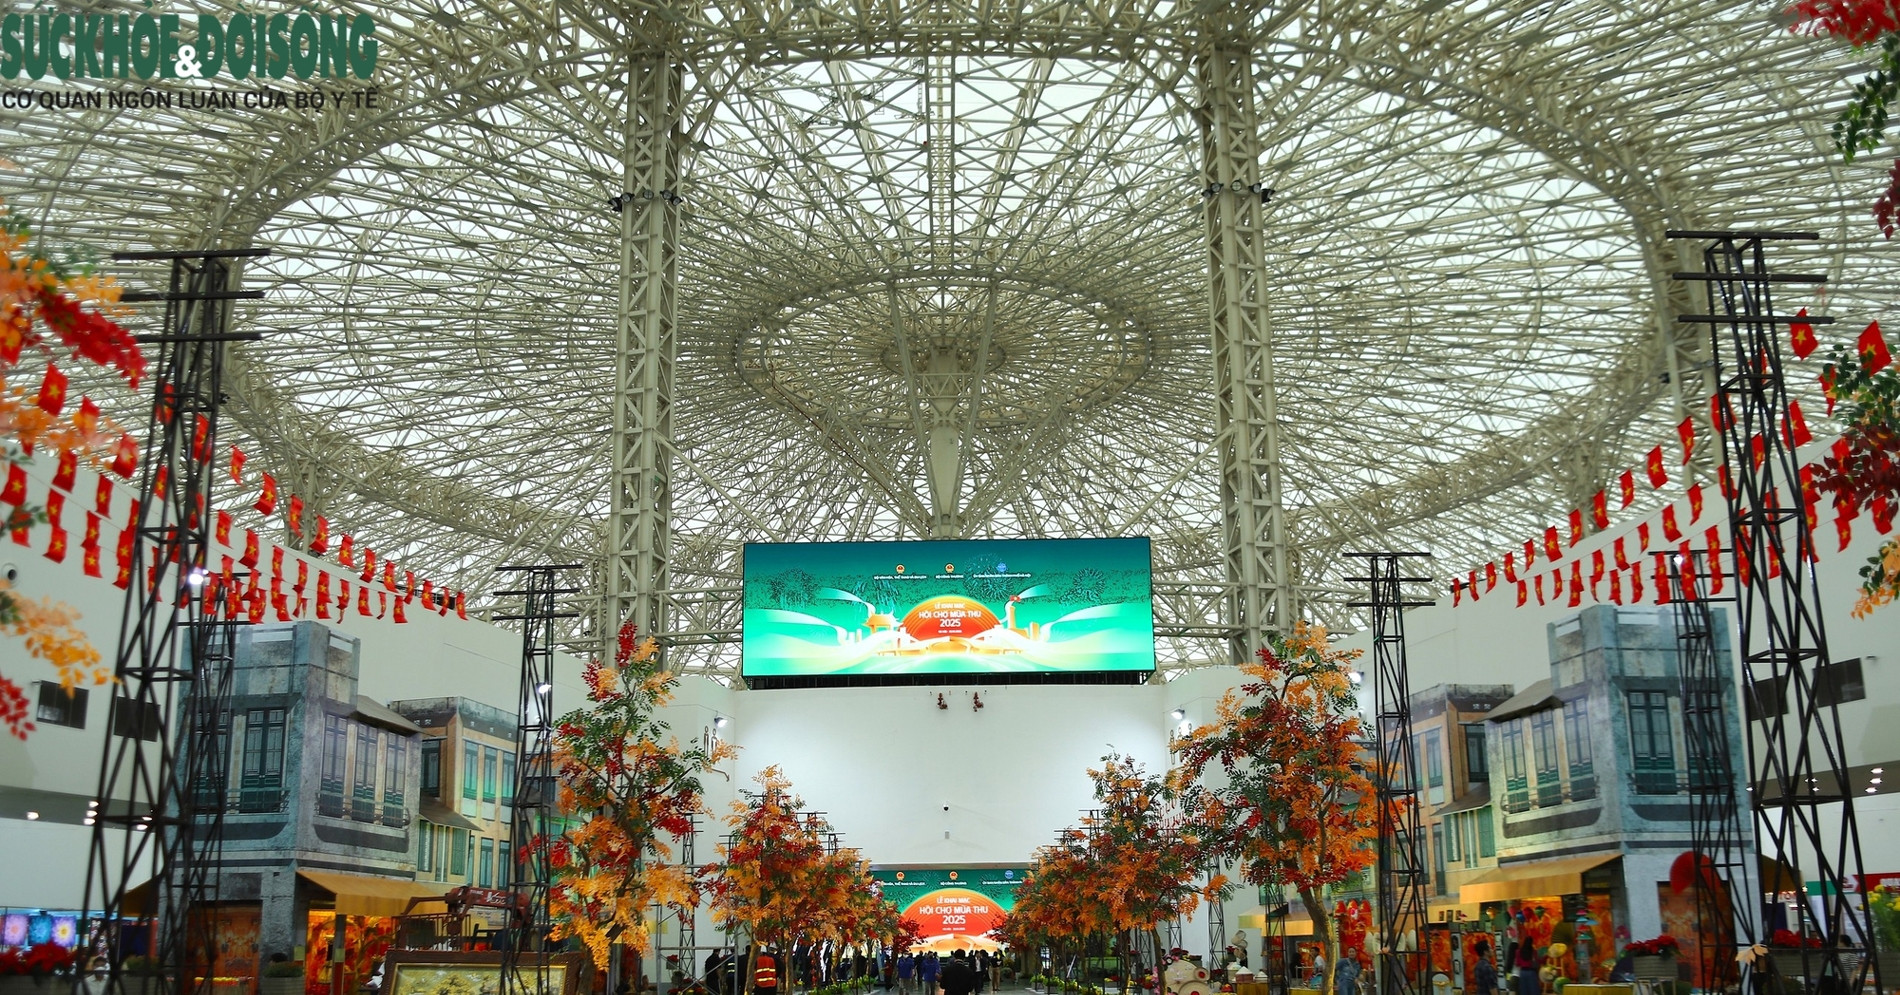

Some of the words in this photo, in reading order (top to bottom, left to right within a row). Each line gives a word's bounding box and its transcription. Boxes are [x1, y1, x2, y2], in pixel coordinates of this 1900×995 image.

[939, 618, 961, 627] 2025
[919, 905, 933, 915] HỘI
[935, 906, 952, 915] CHỢ
[954, 904, 971, 914] MÙA
[973, 905, 988, 914] THU
[942, 915, 966, 925] 2025
